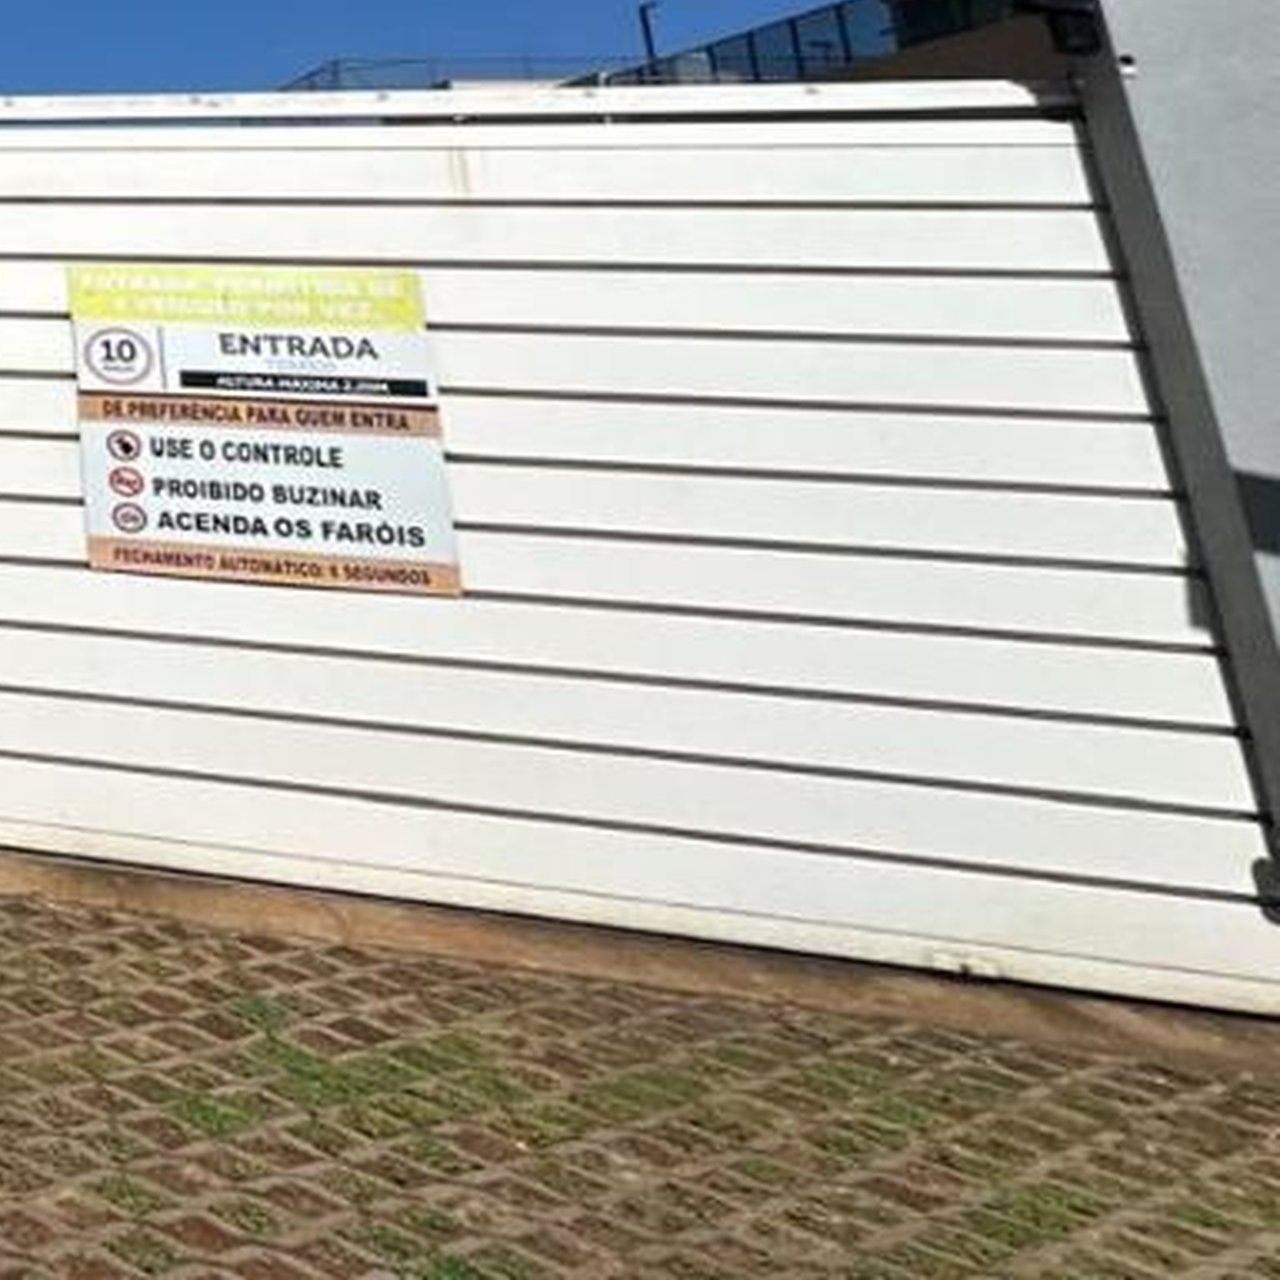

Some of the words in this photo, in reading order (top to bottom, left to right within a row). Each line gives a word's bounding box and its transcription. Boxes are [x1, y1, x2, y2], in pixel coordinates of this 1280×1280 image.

[102, 339, 136, 363] 10
[219, 332, 379, 360] ENTRADA
[246, 404, 290, 424] PARA
[295, 407, 345, 426] QUEM
[350, 411, 411, 431] ENTRA
[150, 437, 193, 459] USE
[199, 439, 216, 461] O
[222, 441, 343, 469] CONTROLE
[152, 477, 264, 502] PROIBIDO
[271, 483, 383, 511] BUZINAR
[157, 510, 269, 537] ACENDA
[273, 517, 312, 540] OS
[321, 520, 426, 548] FARÓIS
[113, 546, 214, 570] FECHAMENTO
[343, 564, 431, 586] SEGUNDOS
